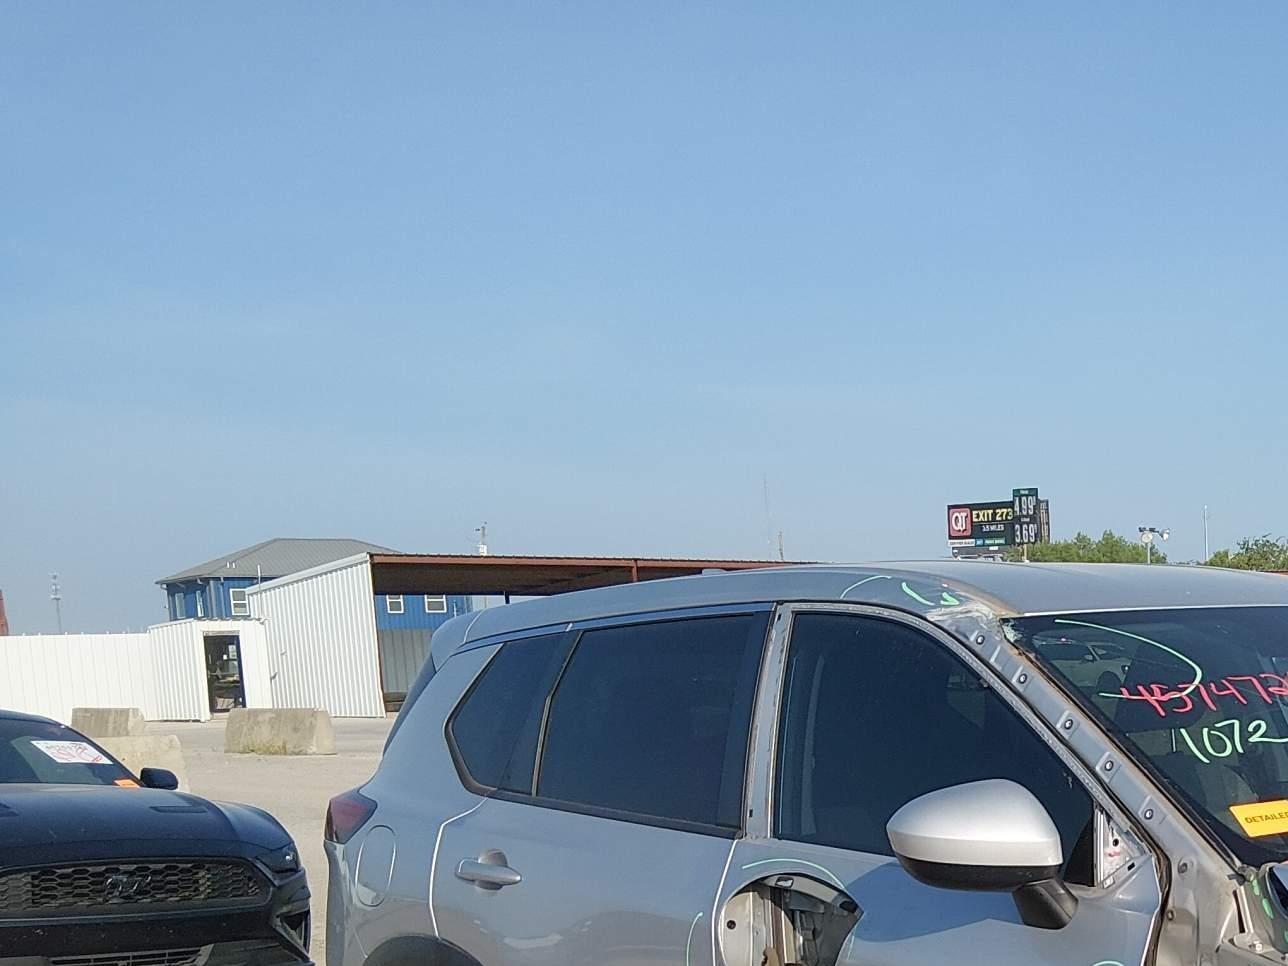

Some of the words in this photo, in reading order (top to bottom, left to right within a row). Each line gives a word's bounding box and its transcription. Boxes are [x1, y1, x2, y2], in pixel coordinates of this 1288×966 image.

[952, 513, 967, 532] QT
[973, 510, 993, 522] EXIT
[996, 509, 1013, 521] 273
